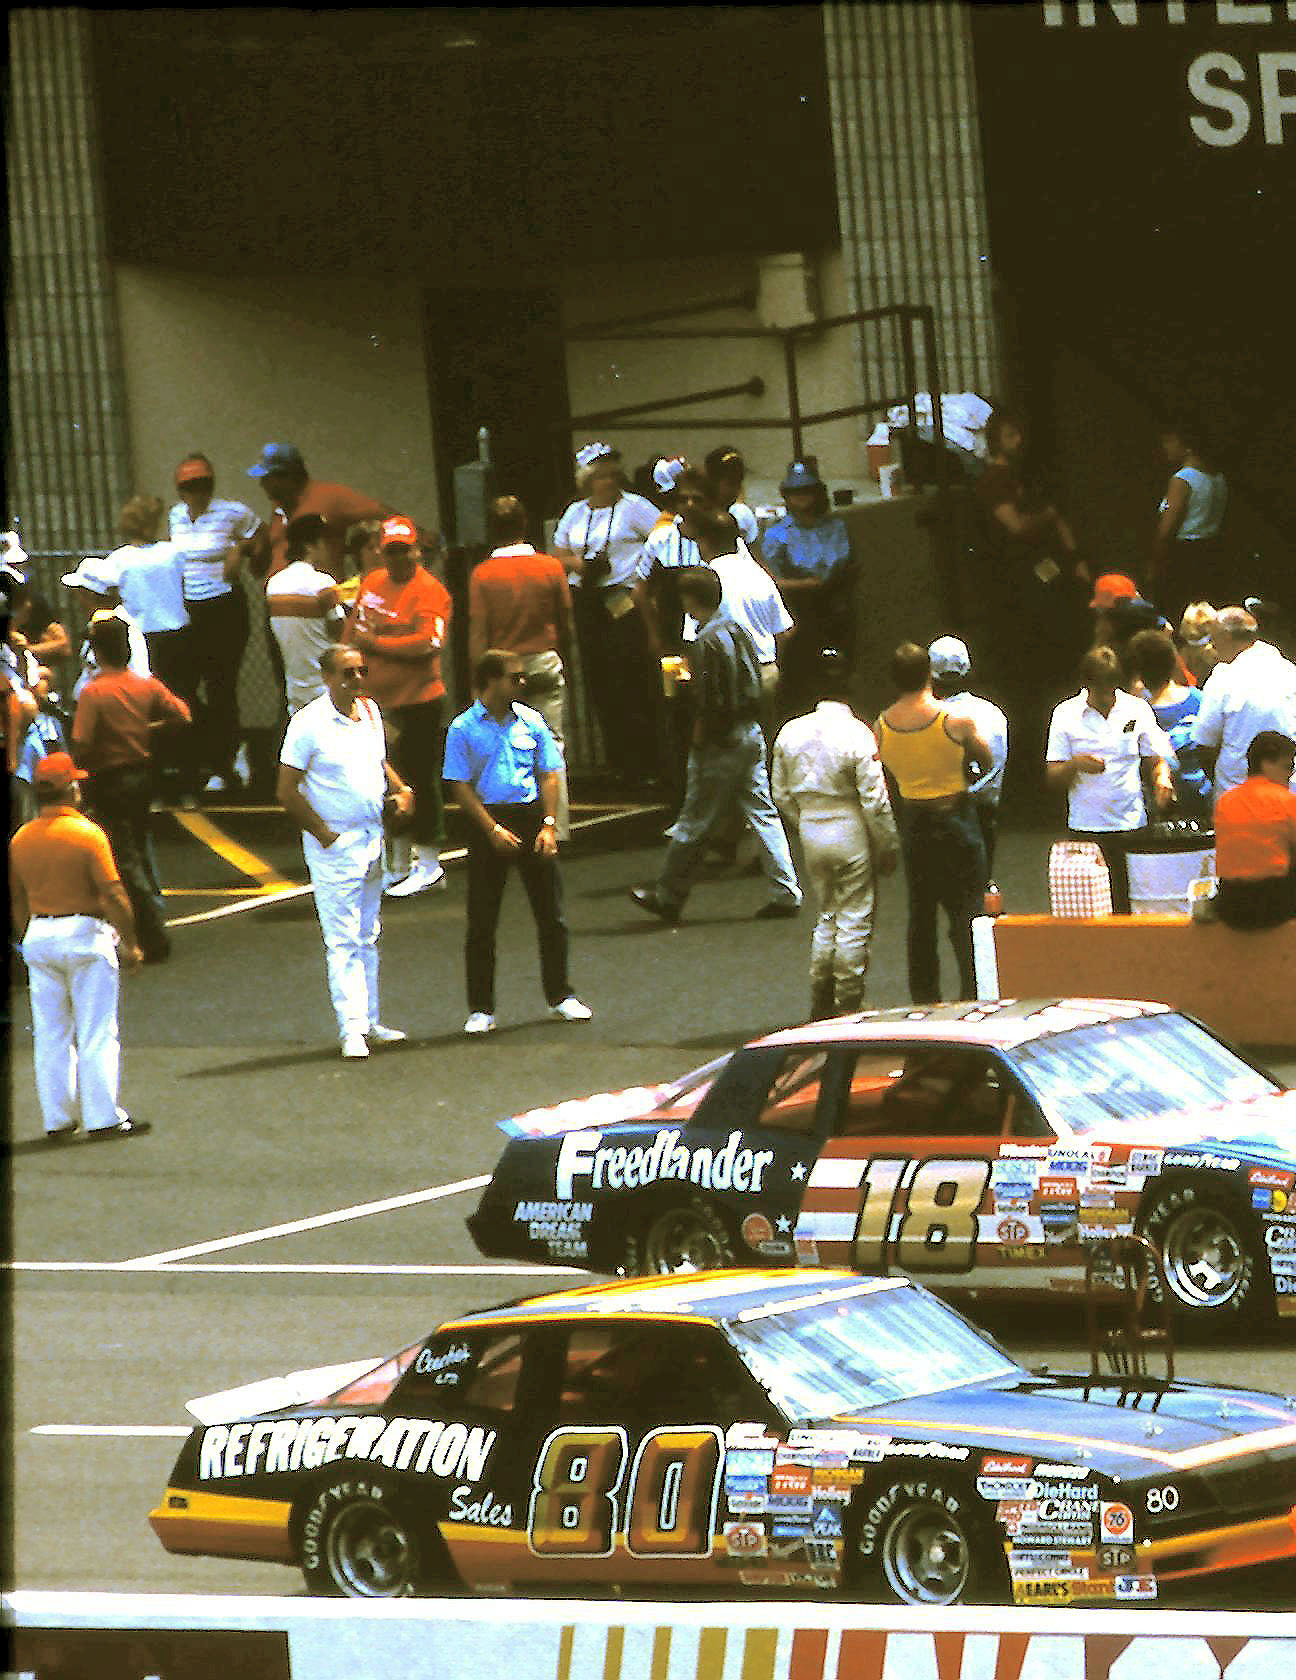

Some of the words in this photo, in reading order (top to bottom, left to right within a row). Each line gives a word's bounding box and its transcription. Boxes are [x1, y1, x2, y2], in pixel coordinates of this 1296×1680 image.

[554, 1127, 774, 1201] Freedlander
[852, 1157, 992, 1273] 18
[198, 1415, 497, 1482] REFRIGERATION
[448, 1485, 514, 1528] Sales
[527, 1423, 726, 1560] 80
[860, 1481, 961, 1556] GOODYEAR
[1033, 1483, 1099, 1499] DieHard
[1145, 1485, 1180, 1513] 80
[1107, 1511, 1127, 1527] 76
[1102, 1549, 1131, 1566] STP
